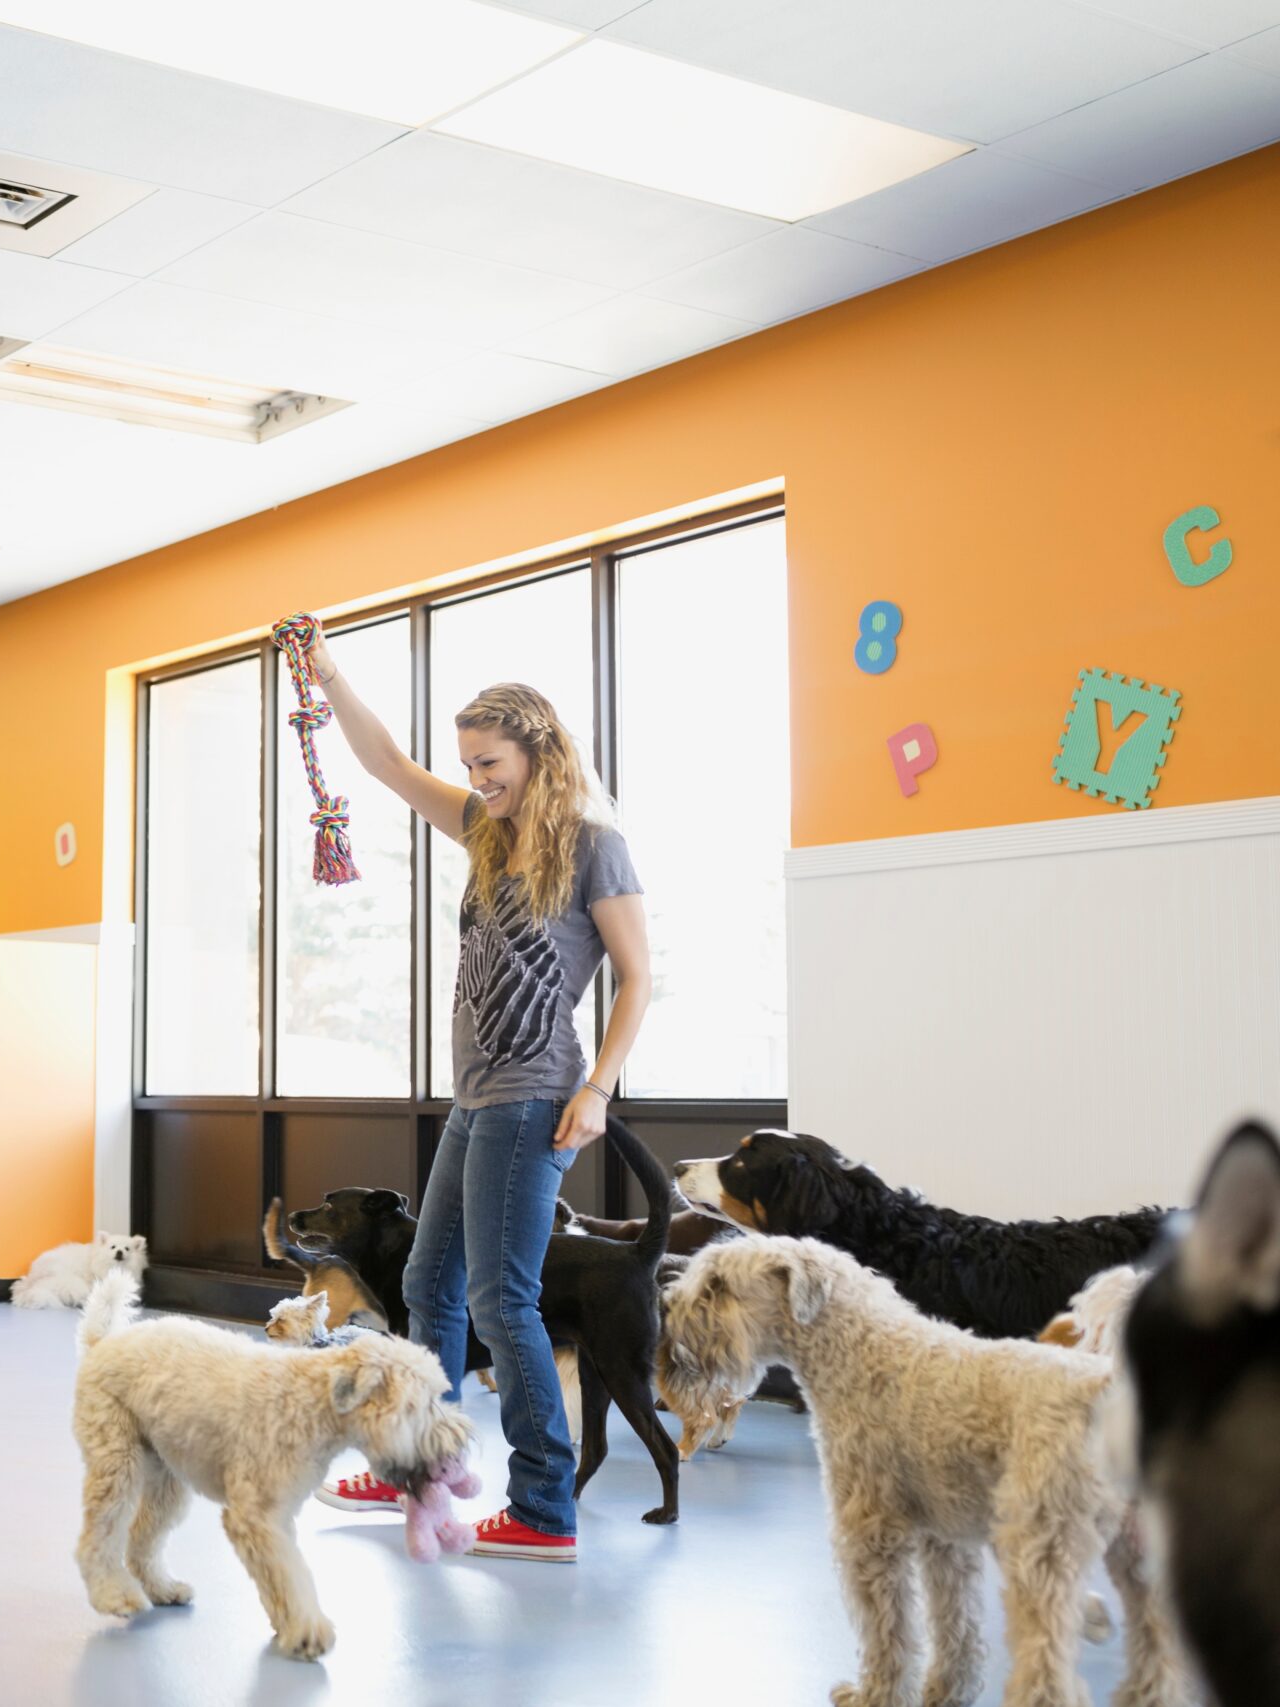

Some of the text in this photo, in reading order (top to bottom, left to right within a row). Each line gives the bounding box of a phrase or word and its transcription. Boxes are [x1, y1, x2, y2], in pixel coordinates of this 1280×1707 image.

[1163, 505, 1232, 586] C
[854, 600, 903, 674] 8
[887, 723, 938, 797] P
[1094, 698, 1149, 776] Y
